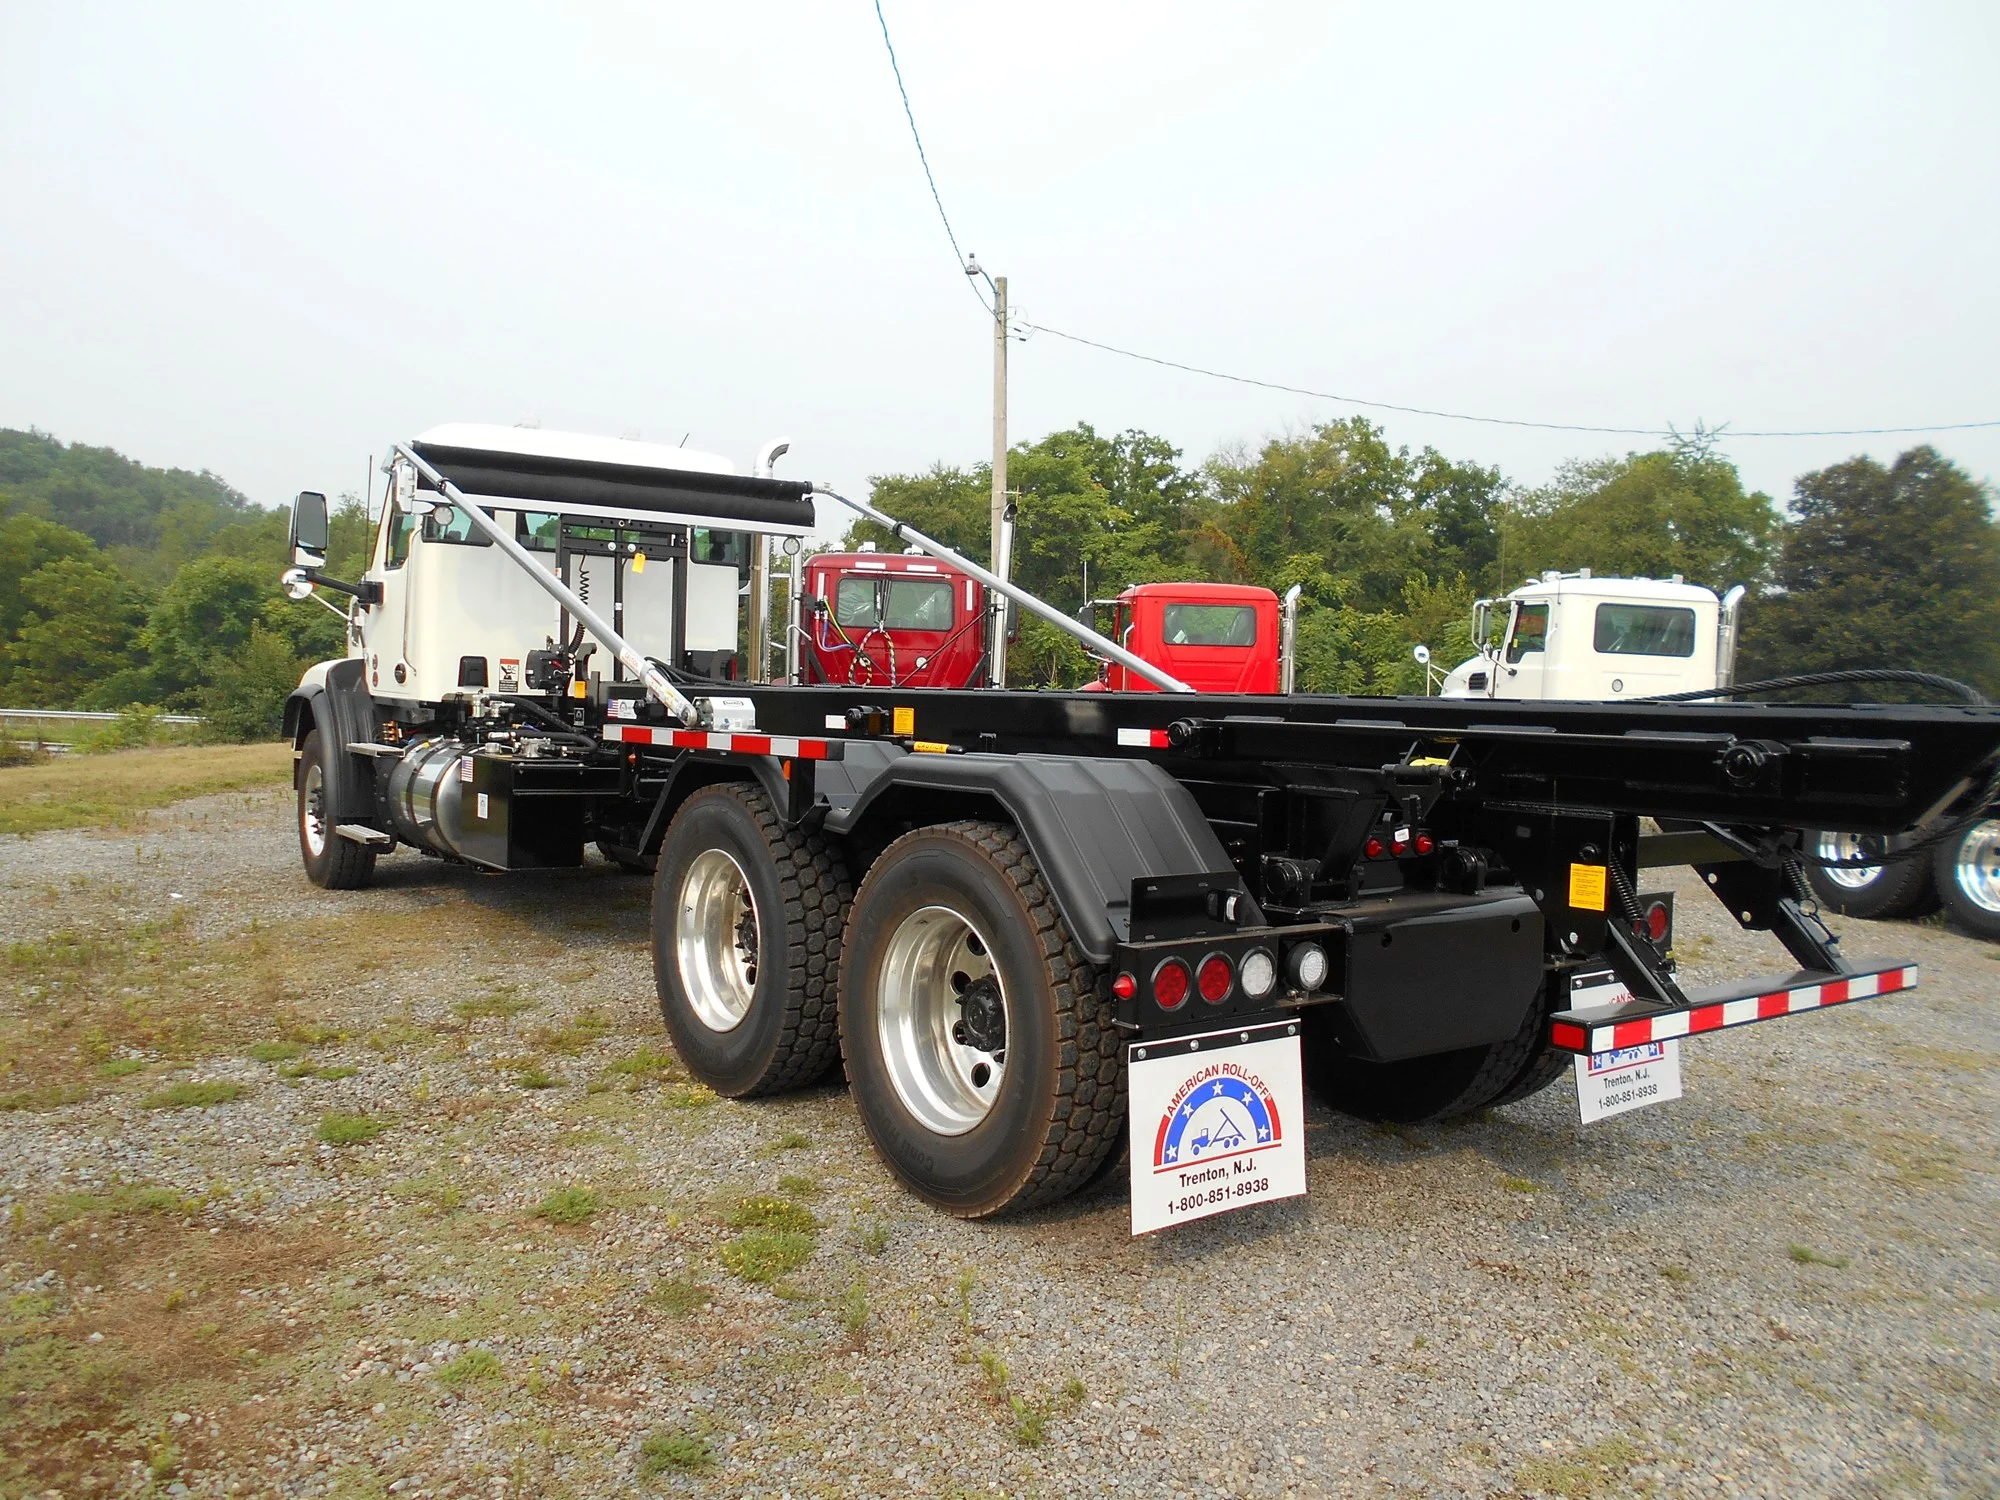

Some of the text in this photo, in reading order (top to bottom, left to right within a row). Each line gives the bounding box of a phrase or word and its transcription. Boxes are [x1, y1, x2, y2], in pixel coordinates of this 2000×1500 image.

[1167, 1063, 1269, 1116] AMERICAN ROLL-OFF
[1604, 1068, 1650, 1089] Trenton, N.J.
[1598, 1084, 1658, 1109] 1-800-851-8938
[1179, 1158, 1257, 1187] Trenton, N.J.
[1167, 1178, 1269, 1215] 1-800-851-8938
